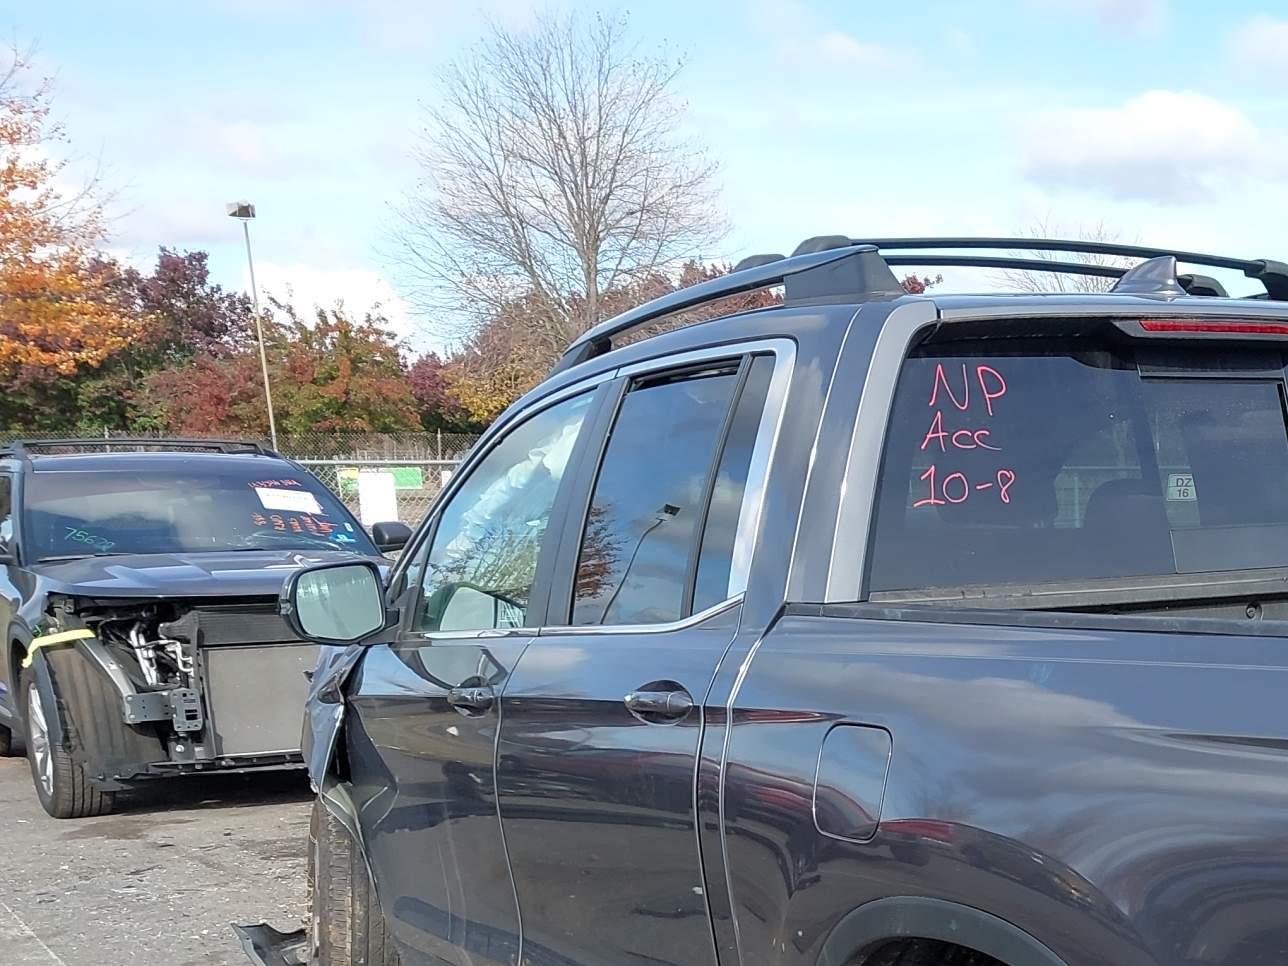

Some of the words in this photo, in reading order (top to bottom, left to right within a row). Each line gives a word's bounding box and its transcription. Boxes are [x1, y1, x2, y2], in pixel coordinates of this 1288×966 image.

[928, 363, 1007, 416] NP
[913, 465, 1015, 507] 10-8
[1177, 488, 1189, 498] 16
